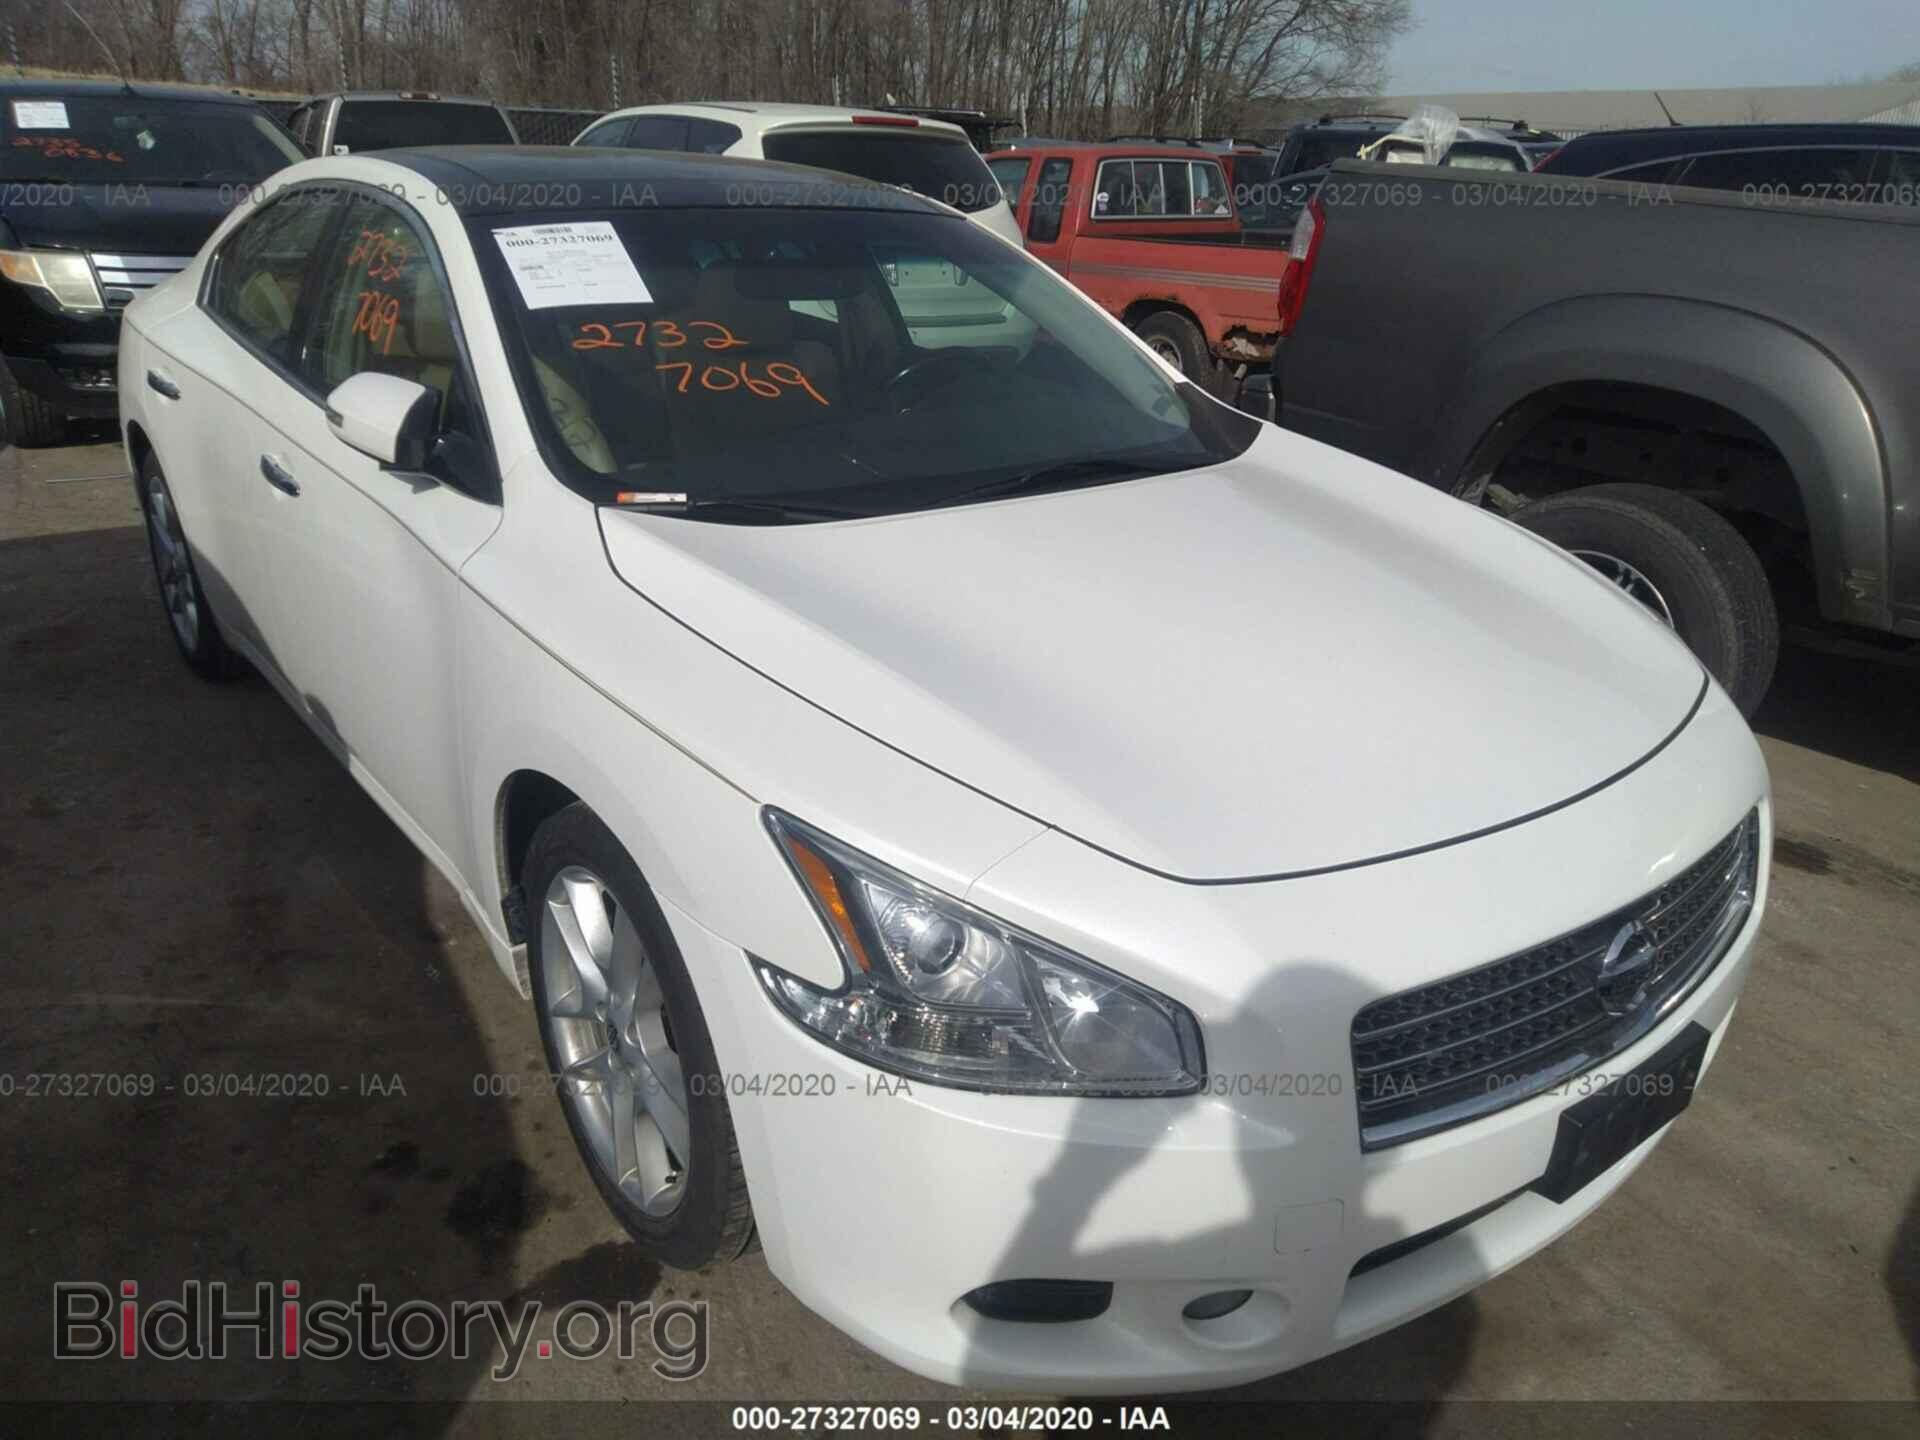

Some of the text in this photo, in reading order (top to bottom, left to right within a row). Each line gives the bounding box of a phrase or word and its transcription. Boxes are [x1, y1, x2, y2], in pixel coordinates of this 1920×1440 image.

[505, 233, 613, 248] 000-27327069
[572, 321, 749, 349] 2732
[656, 361, 829, 406] 7069
